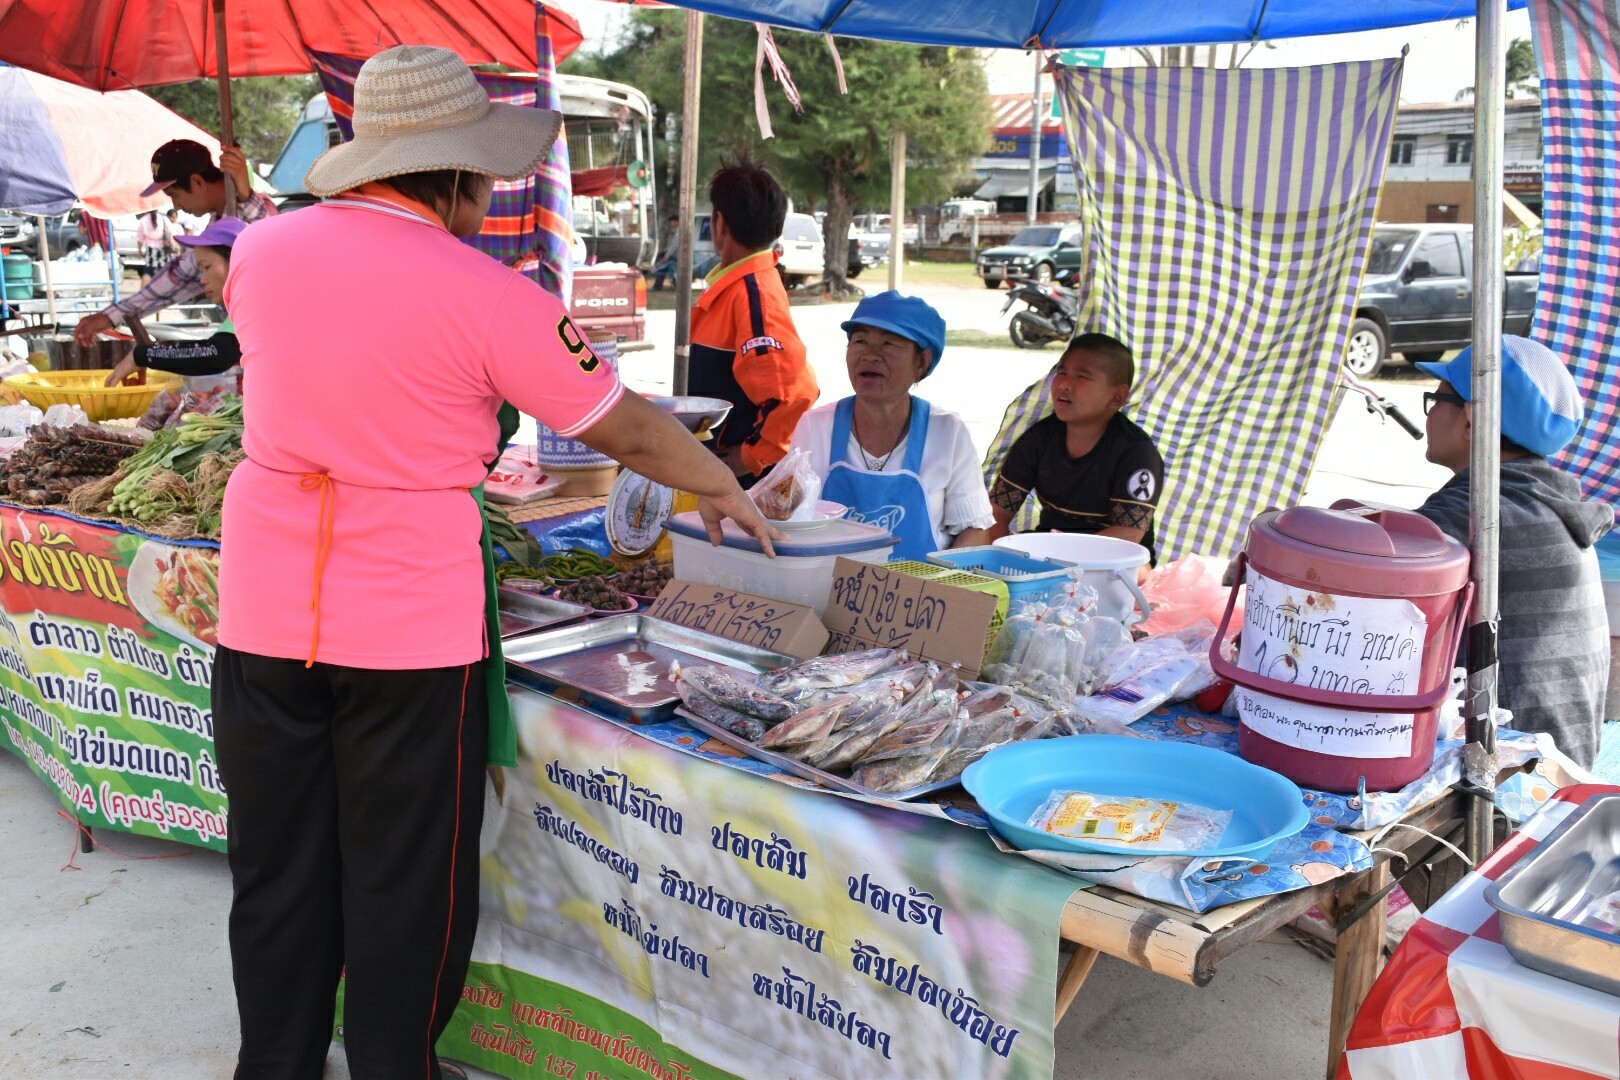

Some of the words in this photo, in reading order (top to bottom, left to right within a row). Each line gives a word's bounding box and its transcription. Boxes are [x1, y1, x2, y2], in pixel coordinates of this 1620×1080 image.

[574, 297, 629, 308] FORD
[0, 512, 129, 606] ไทบ้าน
[29, 612, 101, 654] ตำลาว
[107, 627, 169, 677] ตำไทย
[103, 784, 227, 838] (คุณรุ่งอรุณ
[545, 759, 683, 836] ปลาส้มไร้ก้าง
[711, 821, 808, 880] ปลาส้ม
[847, 872, 944, 935] ปลาร้า
[658, 863, 826, 954] ส้มปลาสร้อย
[850, 939, 1021, 1059] ส้มปลาน้อย
[545, 1053, 577, 1080] 137
